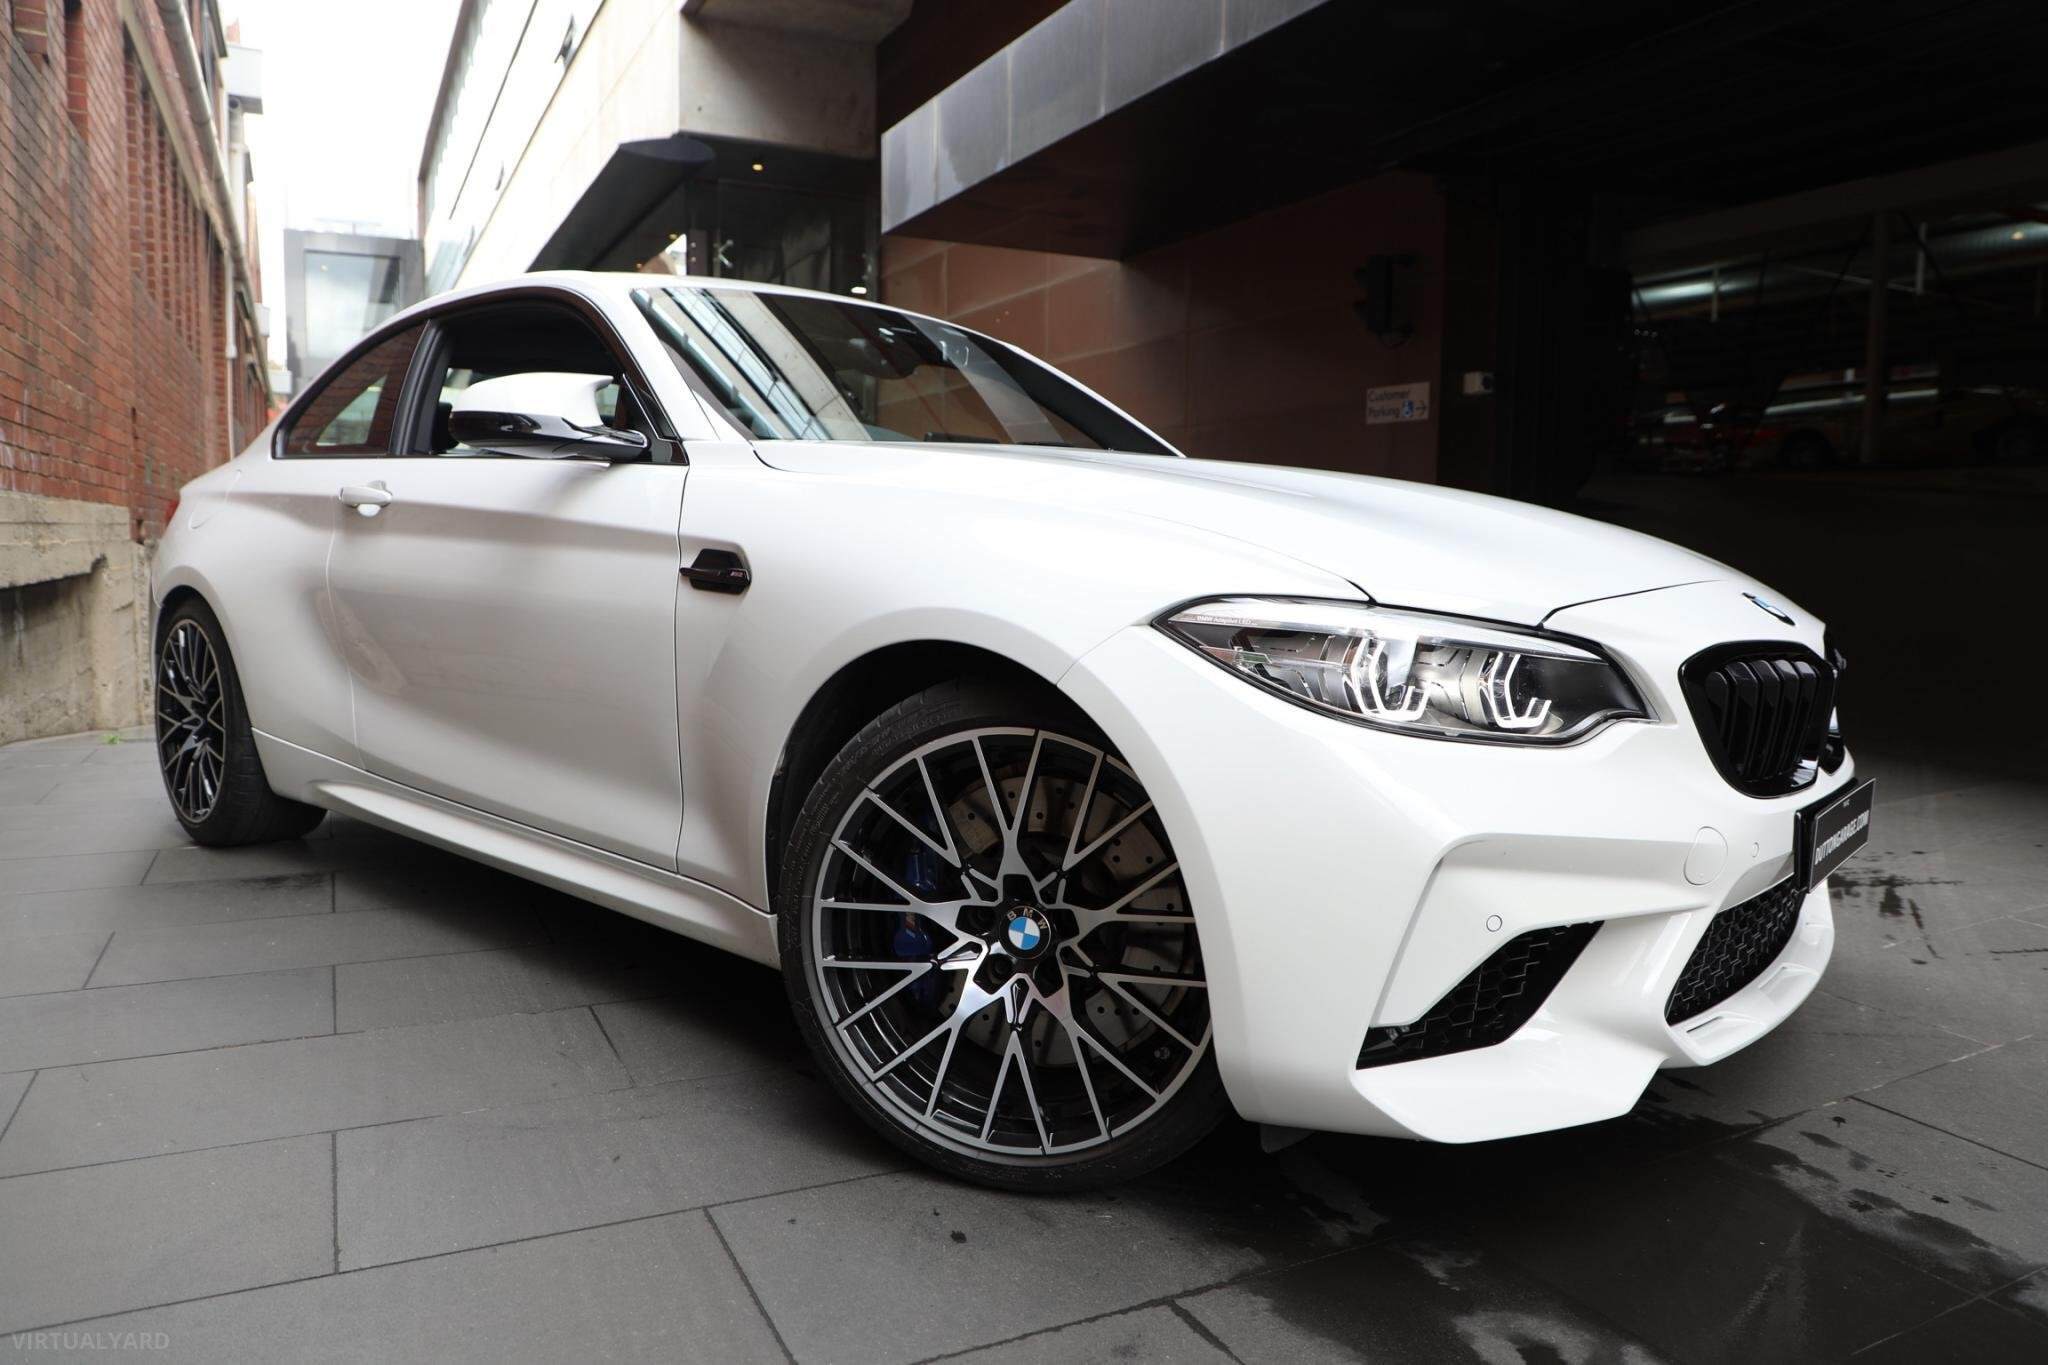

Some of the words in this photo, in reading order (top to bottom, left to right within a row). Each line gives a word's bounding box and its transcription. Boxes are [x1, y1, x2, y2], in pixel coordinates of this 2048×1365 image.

[1368, 390, 1410, 402] Customer
[1369, 406, 1400, 418] Parking
[1814, 809, 1870, 865] DUTTONGARAGE.COM
[1006, 906, 1047, 930] BMW
